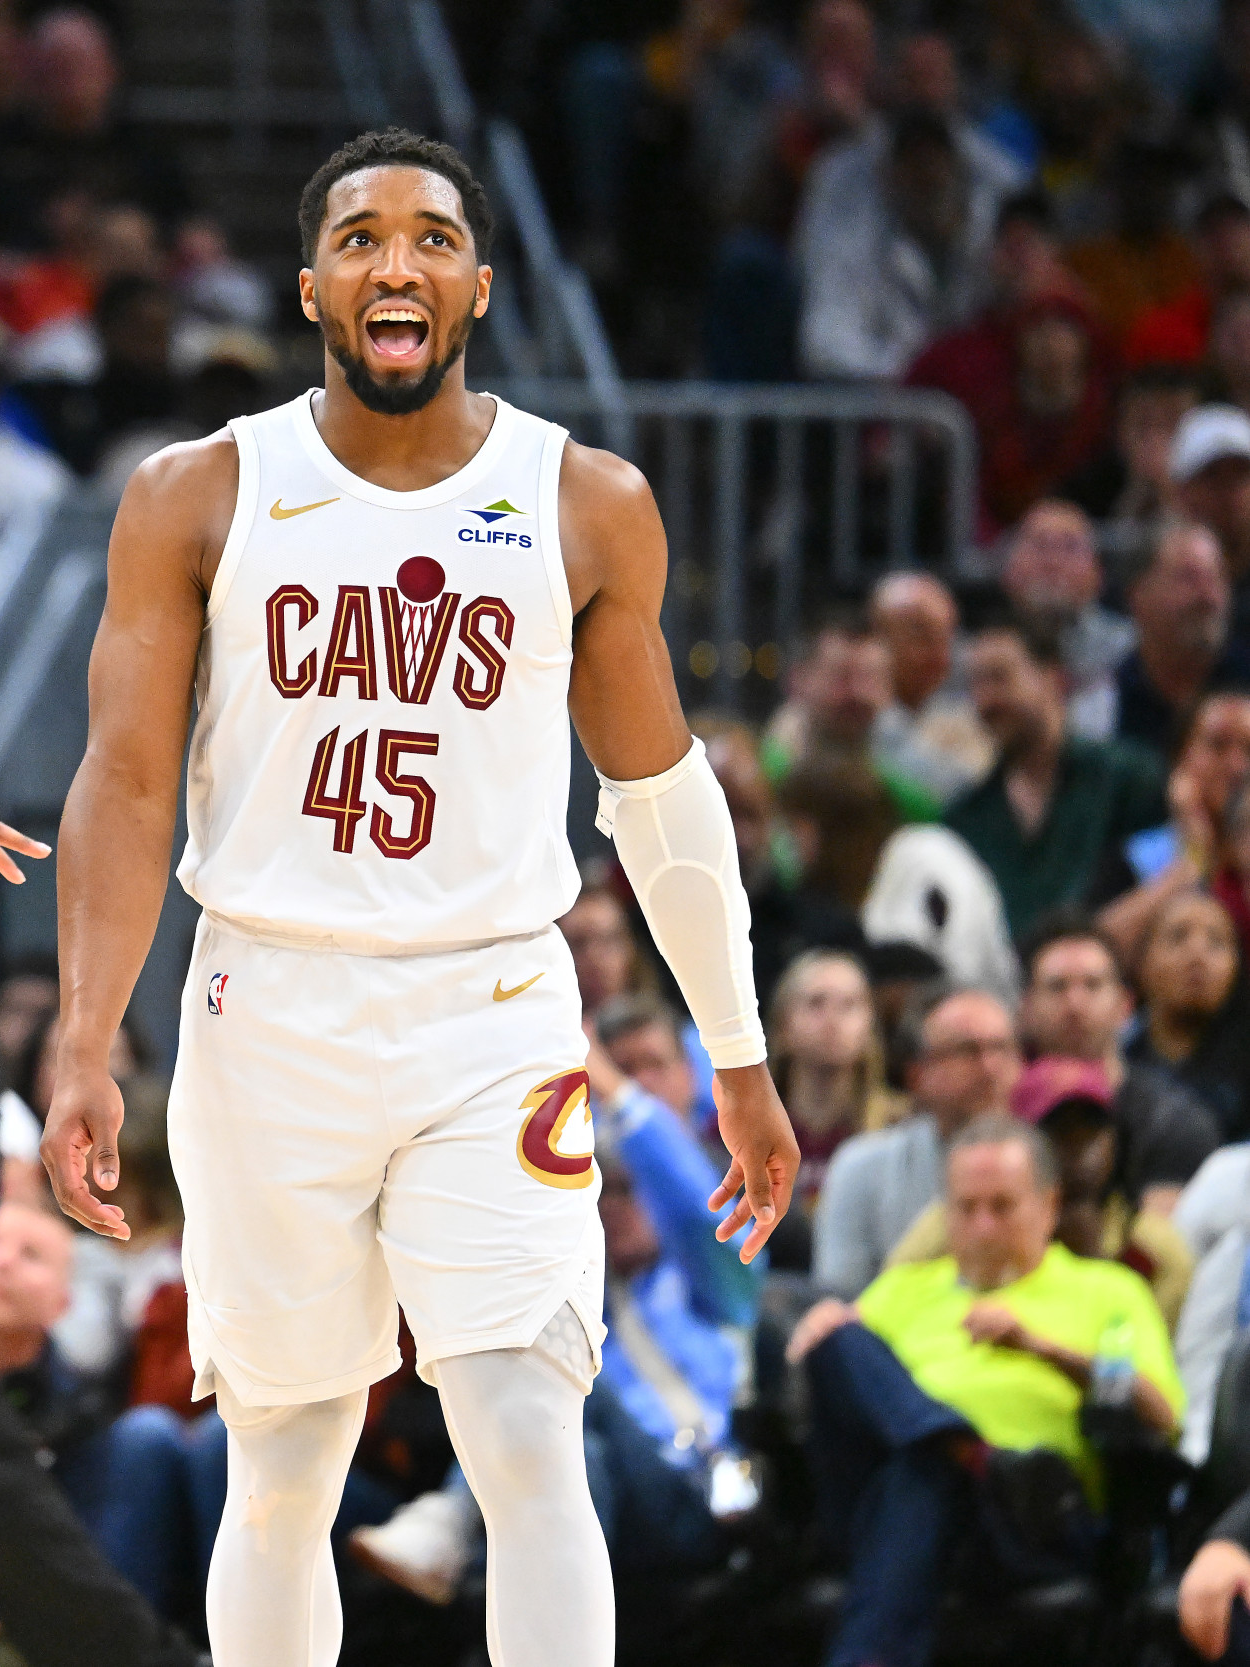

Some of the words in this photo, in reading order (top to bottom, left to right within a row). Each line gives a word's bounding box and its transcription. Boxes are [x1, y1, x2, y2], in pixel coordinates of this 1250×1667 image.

[458, 528, 532, 549] CLIFFS
[265, 584, 515, 711] CAVS
[301, 724, 439, 860] 45
